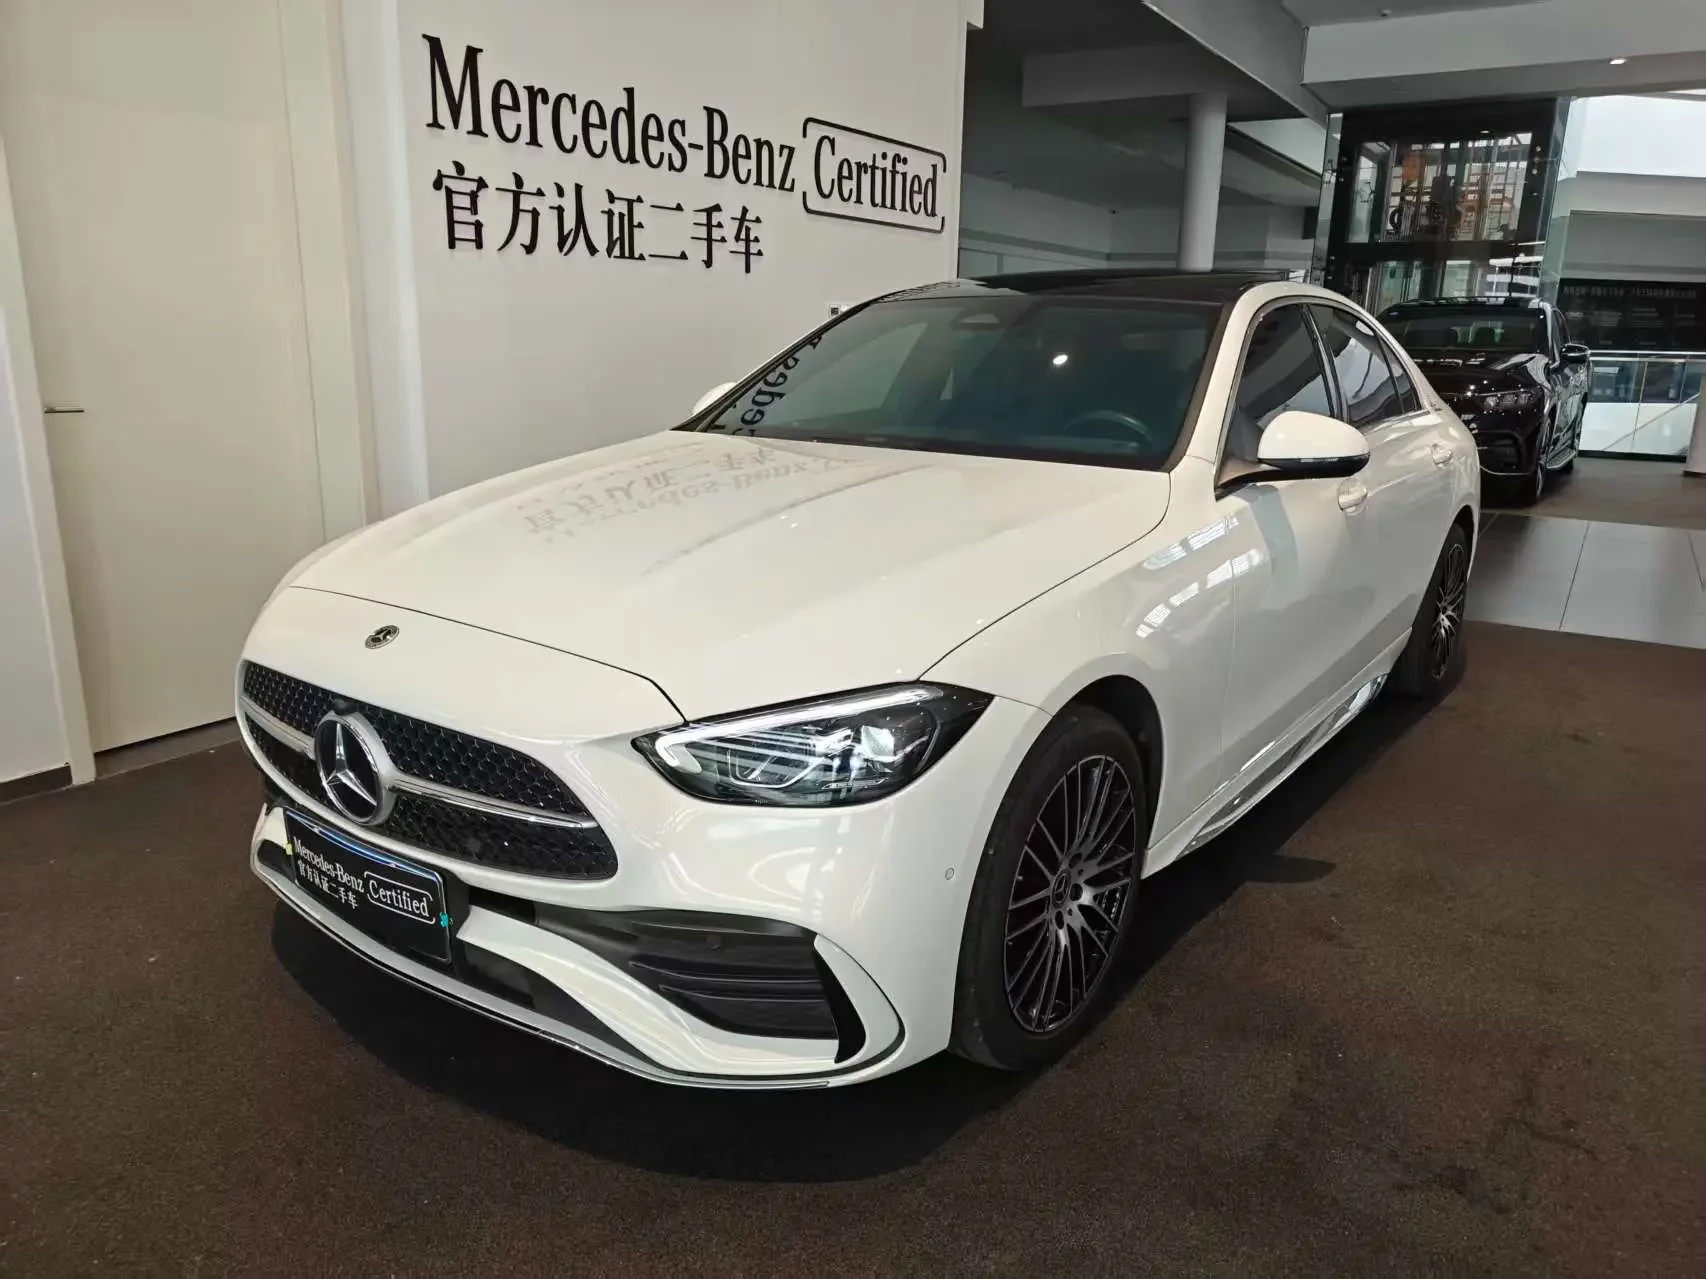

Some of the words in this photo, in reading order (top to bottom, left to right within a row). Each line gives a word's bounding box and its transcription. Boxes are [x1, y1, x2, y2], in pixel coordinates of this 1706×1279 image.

[422, 33, 796, 193] Mercedes-Benz
[814, 135, 938, 218] Certified
[432, 160, 764, 274] 官方认证二手车
[293, 836, 365, 893] Mercedes-Benz
[368, 879, 430, 918] Certified
[297, 859, 358, 910] 官方认证二手车
